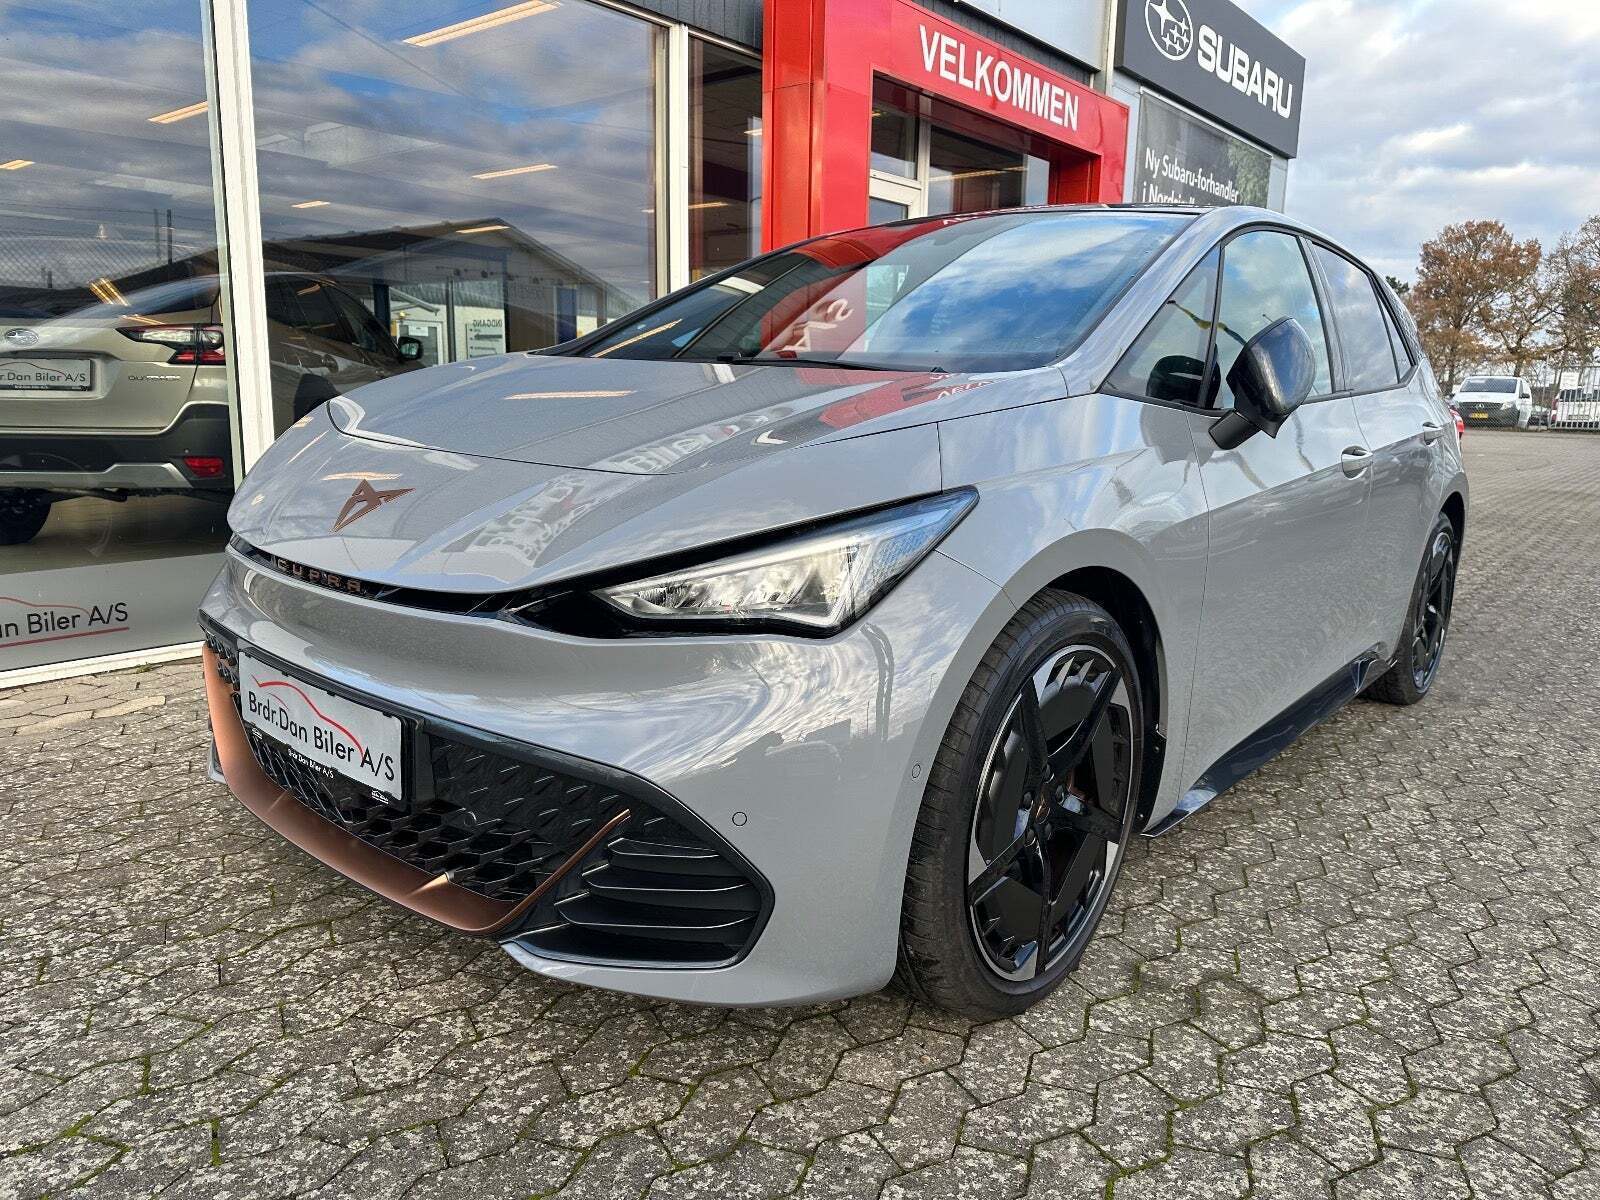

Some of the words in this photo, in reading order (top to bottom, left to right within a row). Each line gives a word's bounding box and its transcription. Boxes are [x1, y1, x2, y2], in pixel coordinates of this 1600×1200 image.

[920, 24, 1079, 132] VELKOMMEN
[1197, 24, 1293, 119] SUBARU
[1145, 147, 1160, 178] Ny
[1162, 155, 1239, 203] Subaru-forhandler
[35, 372, 62, 382] Biler
[65, 373, 86, 382] A/S
[277, 558, 361, 593] CUPRA
[27, 611, 81, 635] Biler
[88, 602, 128, 626] A/S
[248, 691, 308, 743] Brdr.Dan
[313, 725, 355, 762] Biler
[360, 747, 395, 781] A/S
